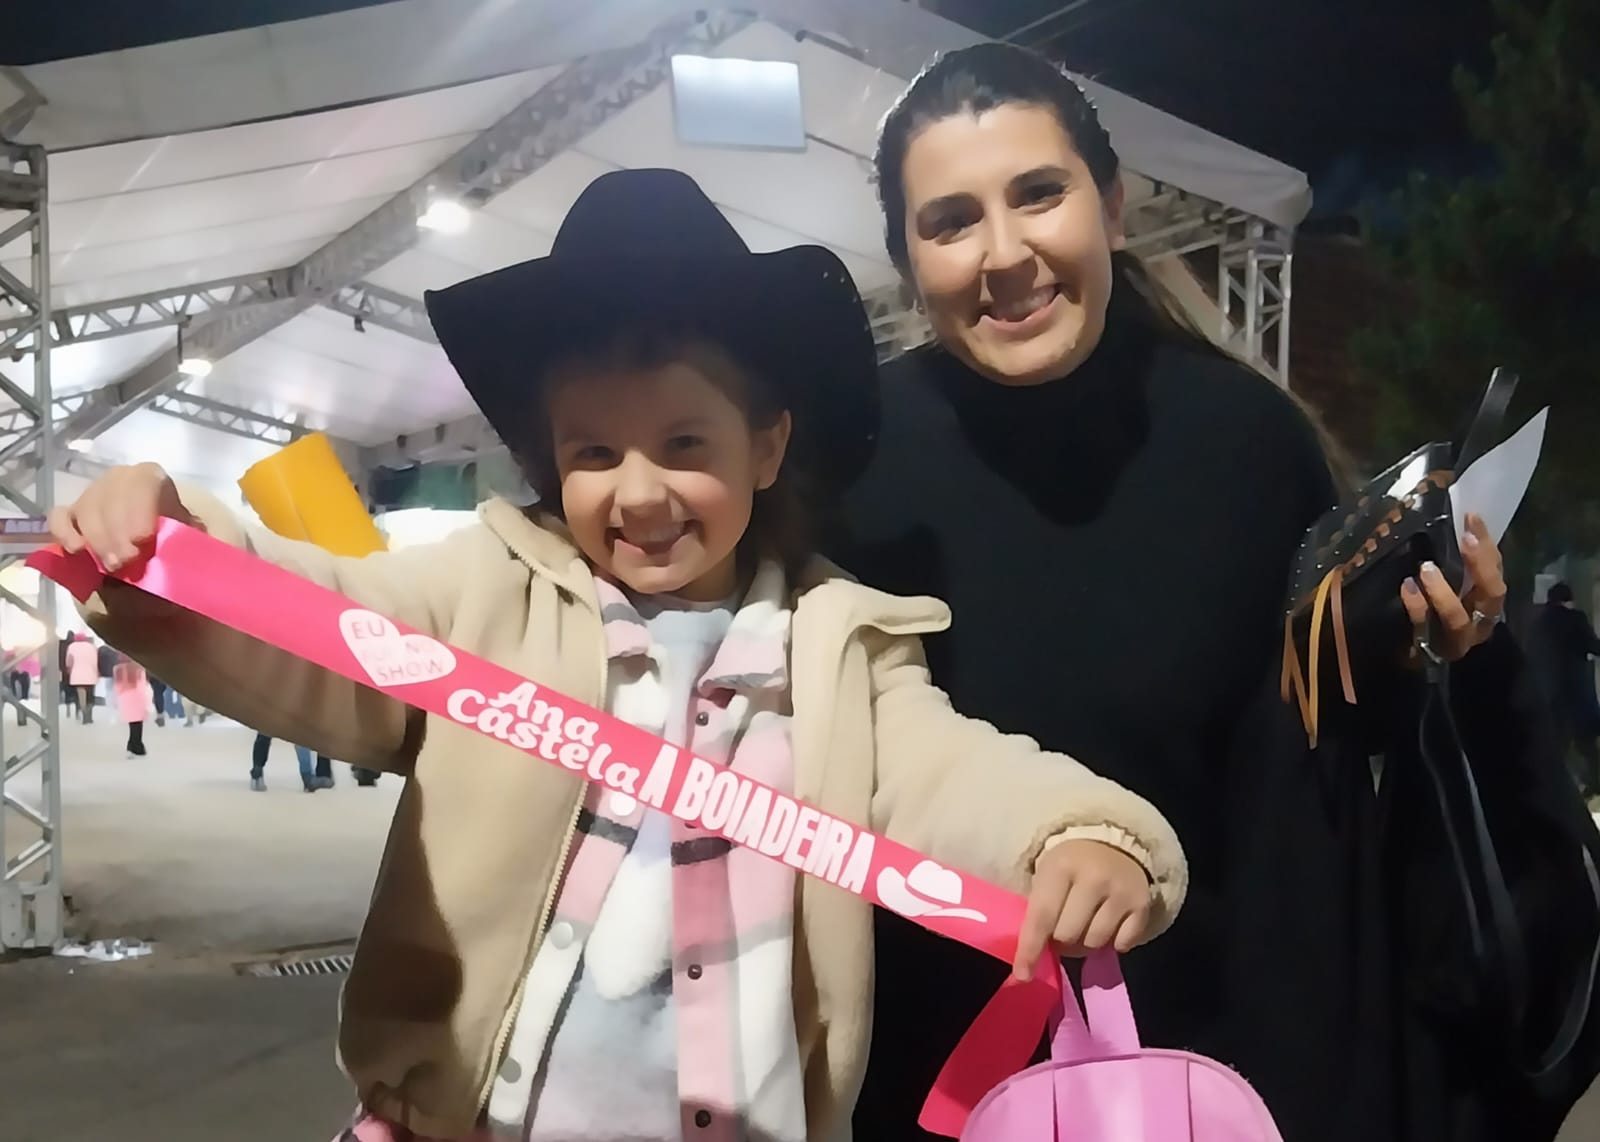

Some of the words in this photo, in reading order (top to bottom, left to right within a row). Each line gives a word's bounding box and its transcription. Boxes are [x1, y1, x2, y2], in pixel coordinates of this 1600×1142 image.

[351, 618, 386, 640] EU
[375, 658, 444, 682] SHOW
[447, 688, 640, 794] Castela
[488, 681, 599, 746] Ana
[638, 743, 678, 809] A
[672, 757, 876, 894] BOIADEIRA
